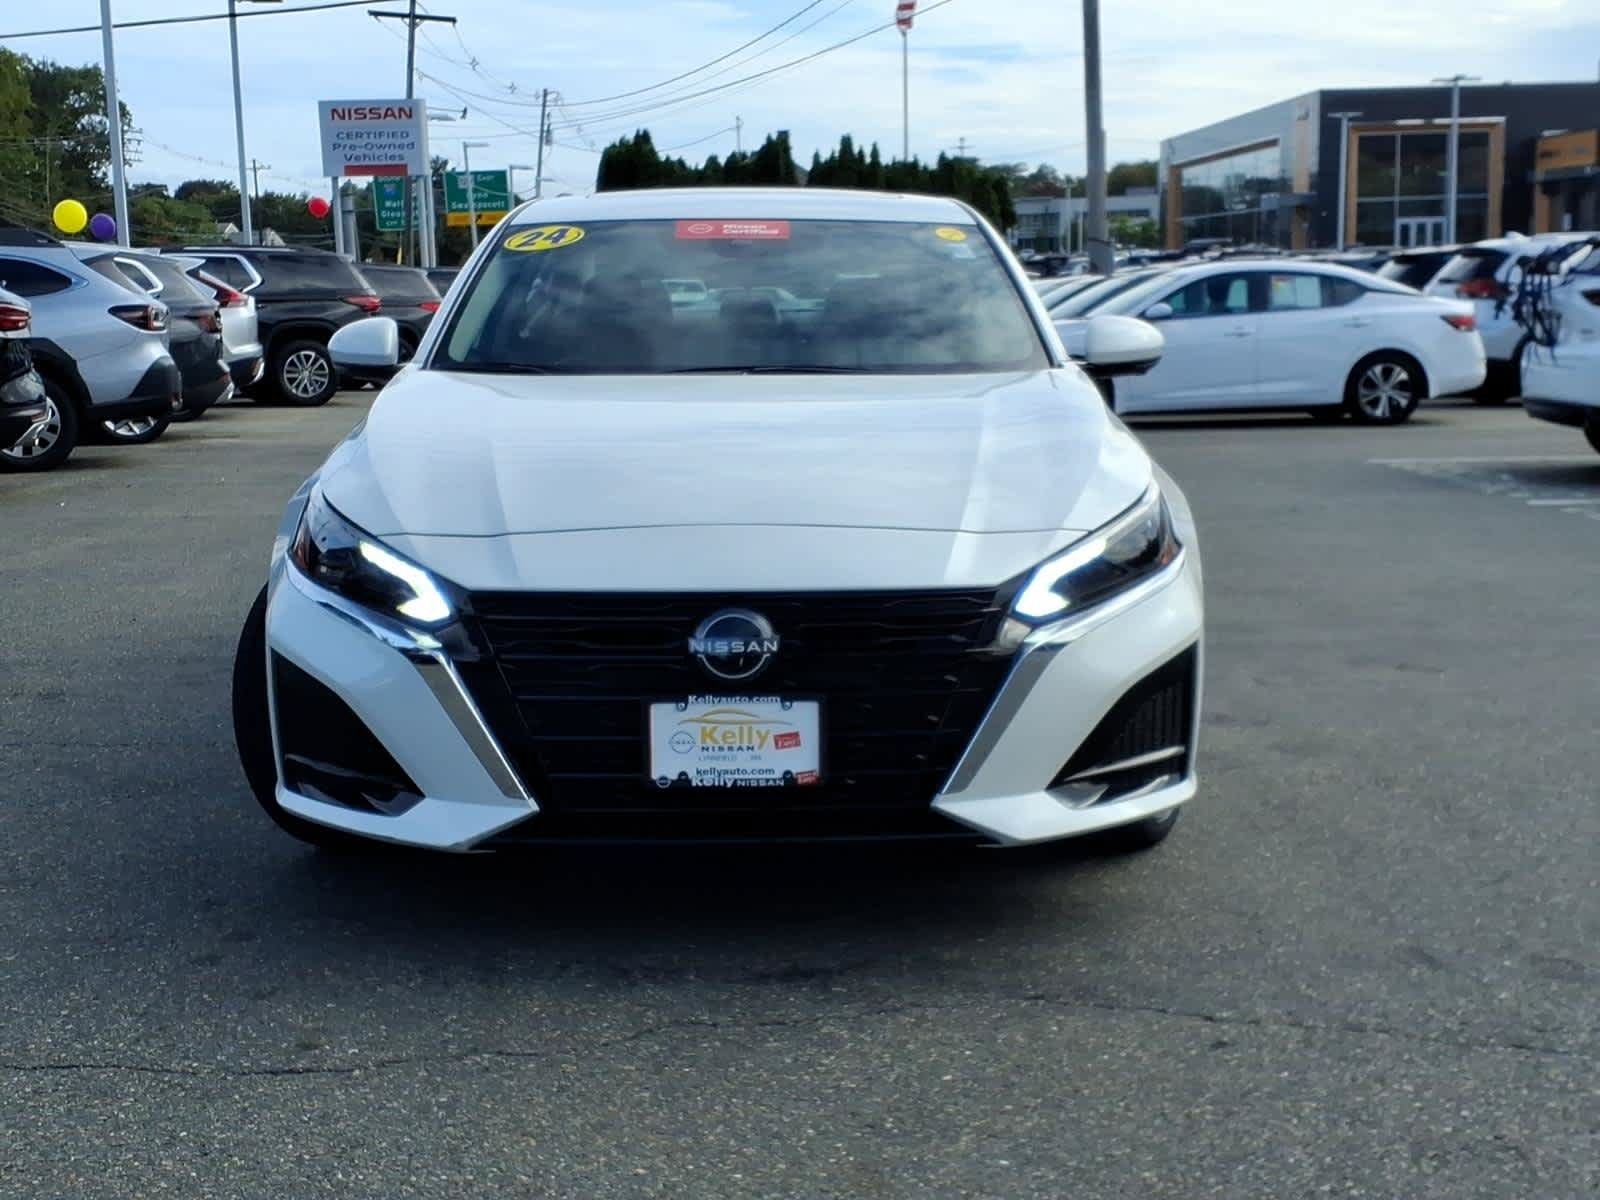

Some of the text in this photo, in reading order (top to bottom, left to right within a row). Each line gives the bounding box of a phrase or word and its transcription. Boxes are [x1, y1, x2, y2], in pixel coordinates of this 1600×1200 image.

[331, 106, 413, 120] NISSAN
[336, 130, 409, 141] CERTIFIED
[332, 141, 416, 152] Pre-Owned
[344, 153, 405, 162] Vehicles
[515, 228, 569, 248] 24
[688, 639, 779, 653] NISSAN
[700, 725, 770, 750] Kelly
[696, 767, 775, 777] kellyauto.com
[691, 776, 734, 788] Kelly
[736, 778, 784, 787] NISSAN
